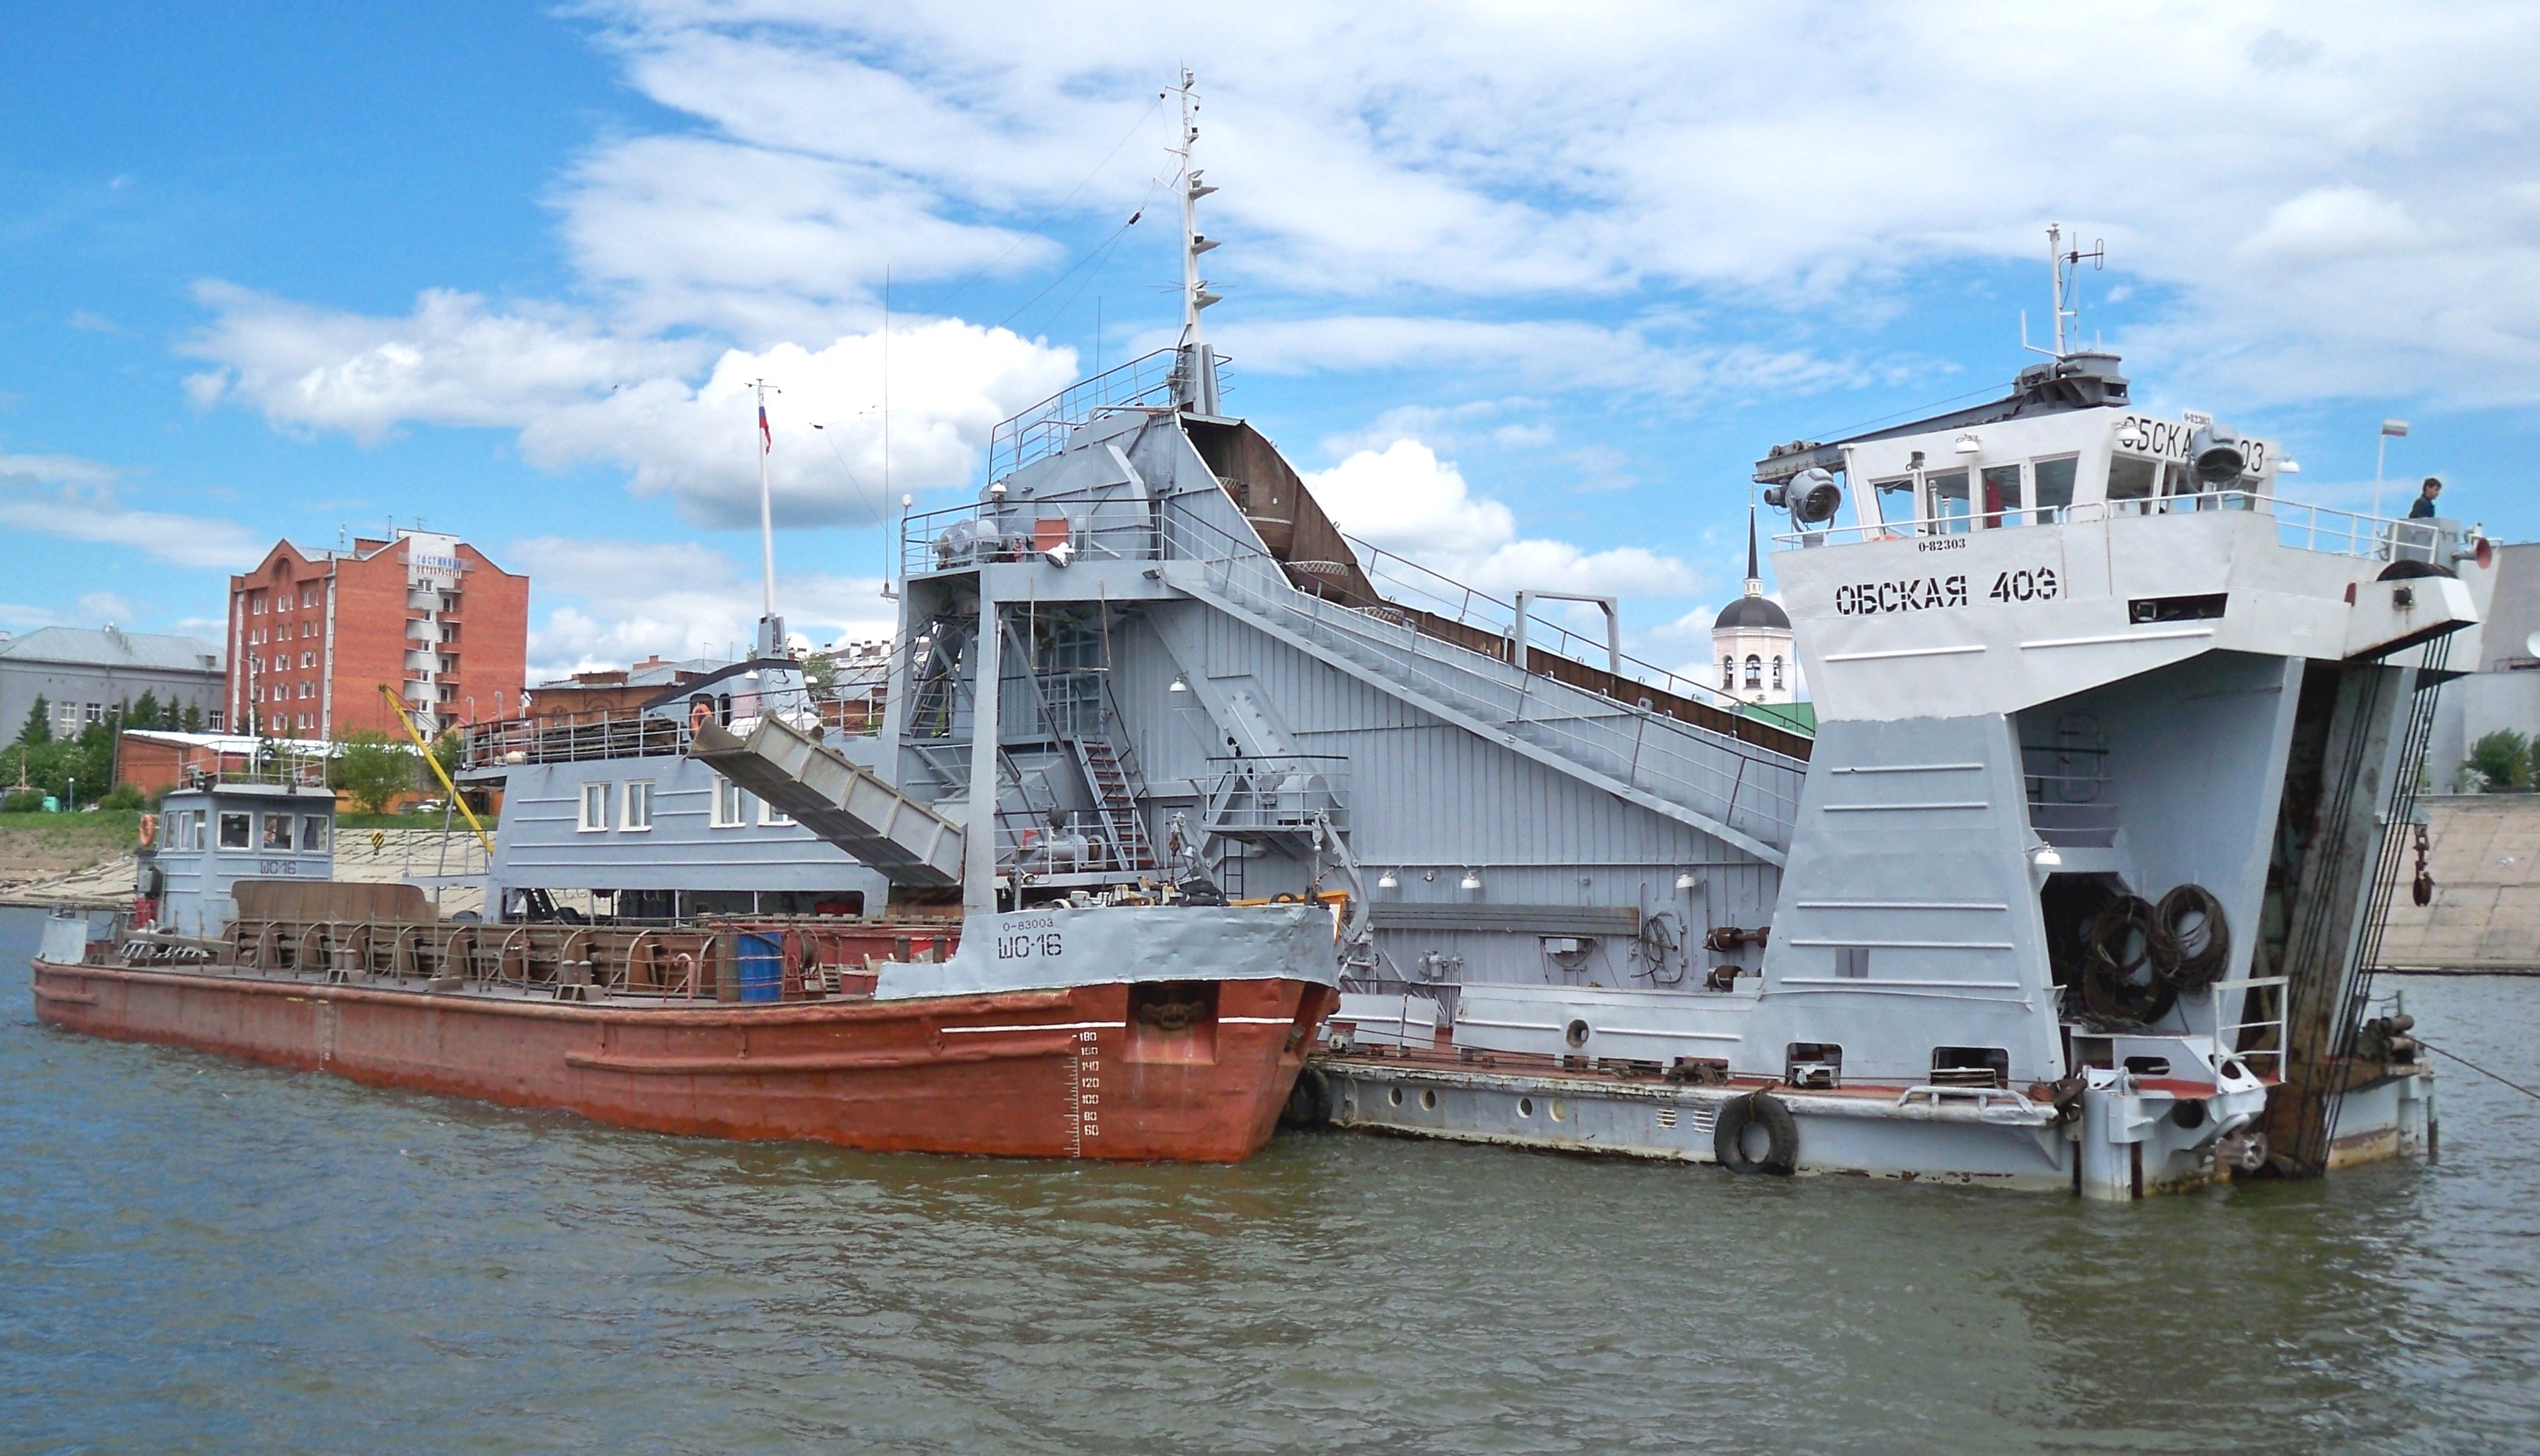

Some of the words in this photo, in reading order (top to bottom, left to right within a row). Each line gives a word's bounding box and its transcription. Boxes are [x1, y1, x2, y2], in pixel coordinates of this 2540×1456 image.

[1835, 574, 1968, 615] ОБСКАЯ
[1988, 566, 2058, 603] 403
[1080, 1031, 1097, 1042] 180
[1082, 1061, 1099, 1072] 140
[1081, 1078, 1099, 1088] 120
[1082, 1094, 1099, 1105] 100
[1083, 1111, 1097, 1122] 80
[1084, 1124, 1099, 1136] 60
